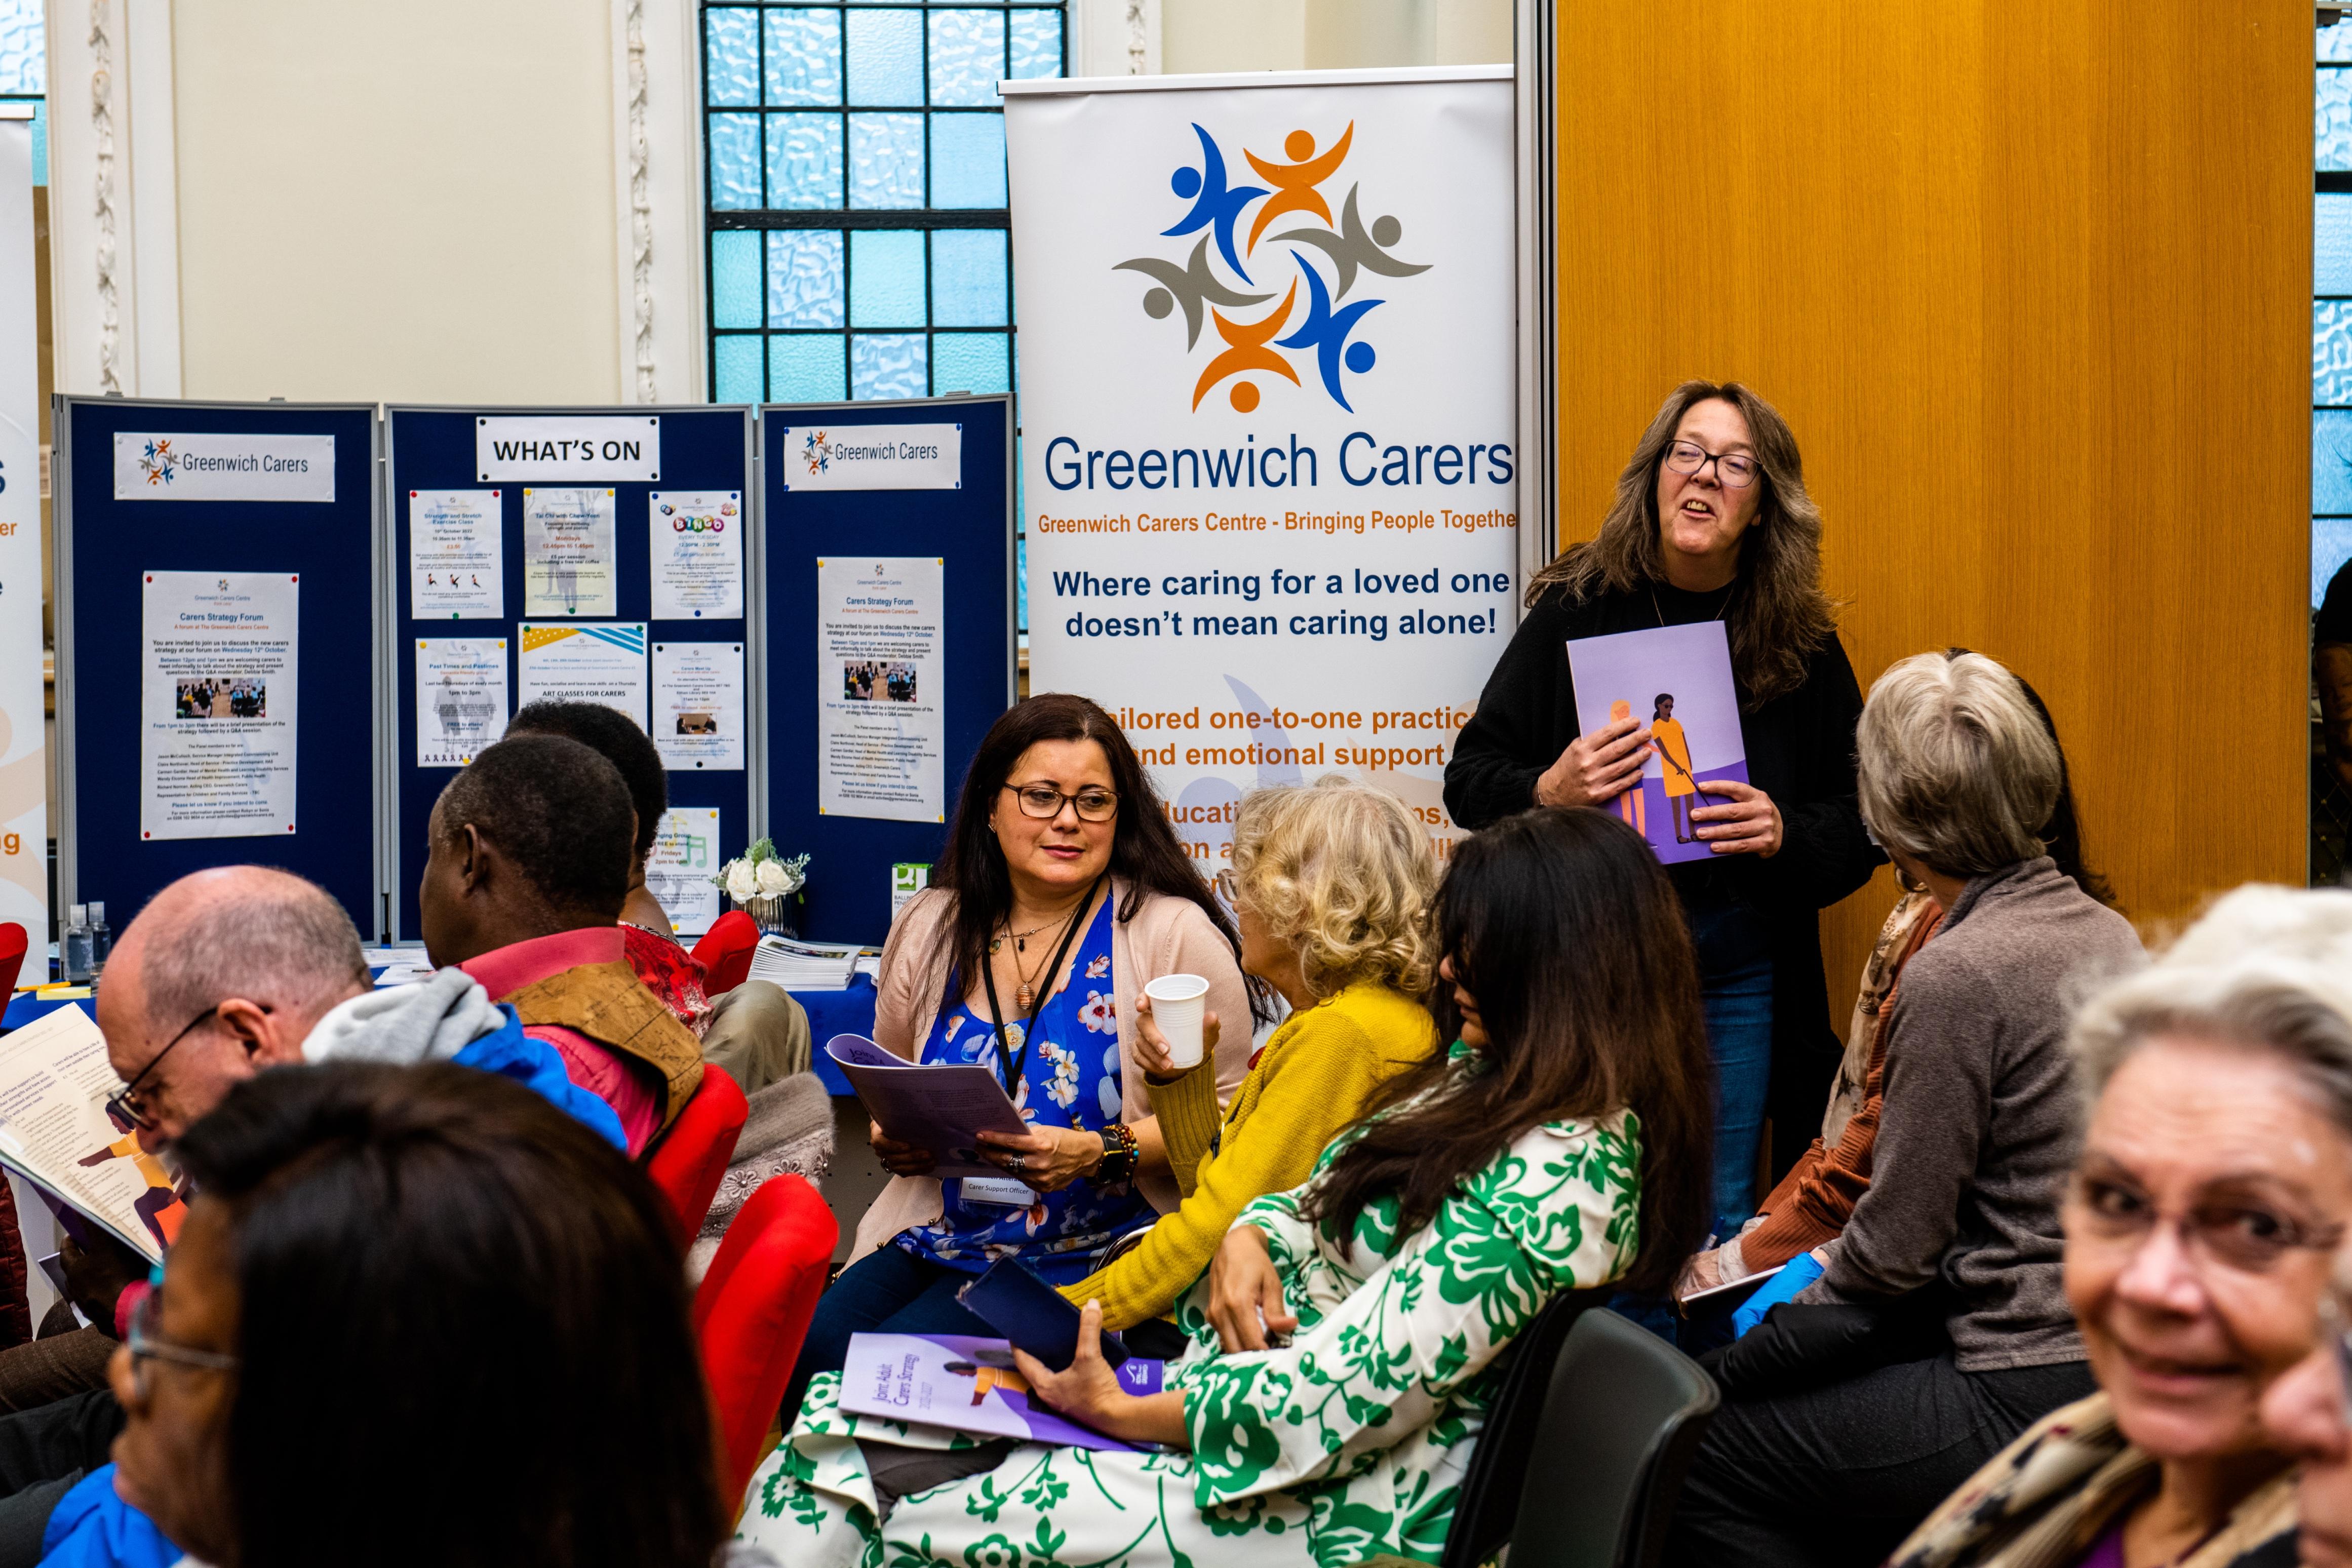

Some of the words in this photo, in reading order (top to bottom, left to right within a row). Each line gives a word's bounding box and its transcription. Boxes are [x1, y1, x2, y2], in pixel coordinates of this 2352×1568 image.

[494, 441, 593, 460] WHAT'S
[603, 442, 640, 460] ON
[835, 444, 895, 459] Greenwich
[899, 443, 937, 459] Carers
[1045, 433, 1316, 489] Greenwich
[1340, 430, 1514, 486] Carers
[183, 454, 258, 471] Greenwich
[263, 455, 307, 472] Carers
[677, 517, 721, 530] BINGO
[1038, 514, 1130, 533] Greenwich
[1138, 514, 1198, 532] Carers
[1205, 513, 1266, 531] Centre
[1285, 512, 1364, 535] Bringing
[1371, 511, 1434, 534] People
[1053, 571, 1150, 596] Where
[1162, 570, 1260, 602] caring
[1272, 568, 1315, 594] for
[1326, 576, 1342, 594] a
[1355, 569, 1438, 594] loved
[1452, 575, 1510, 593] one
[868, 598, 892, 607] Strategy
[207, 613, 238, 622] Strategy
[1066, 612, 1182, 637] doesn't
[1193, 617, 1277, 636] mean
[1290, 610, 1387, 641] caring
[1399, 609, 1495, 634] alone!
[1103, 707, 1199, 729] ilored
[1210, 706, 1362, 729] one-to-one
[1373, 706, 1476, 734] practic
[1133, 742, 1175, 765] nd
[1185, 742, 1324, 765] emotional
[1335, 743, 1445, 771] support
[849, 1048, 877, 1062] Joint
[9, 1088, 25, 1102] strengths
[31, 1081, 40, 1089] have
[40, 1075, 51, 1083] access
[17, 1078, 31, 1089] support
[876, 1363, 892, 1382] Adult
[896, 1354, 920, 1382] Strategy
[872, 1384, 892, 1404] Joint
[893, 1382, 911, 1406] Carers
